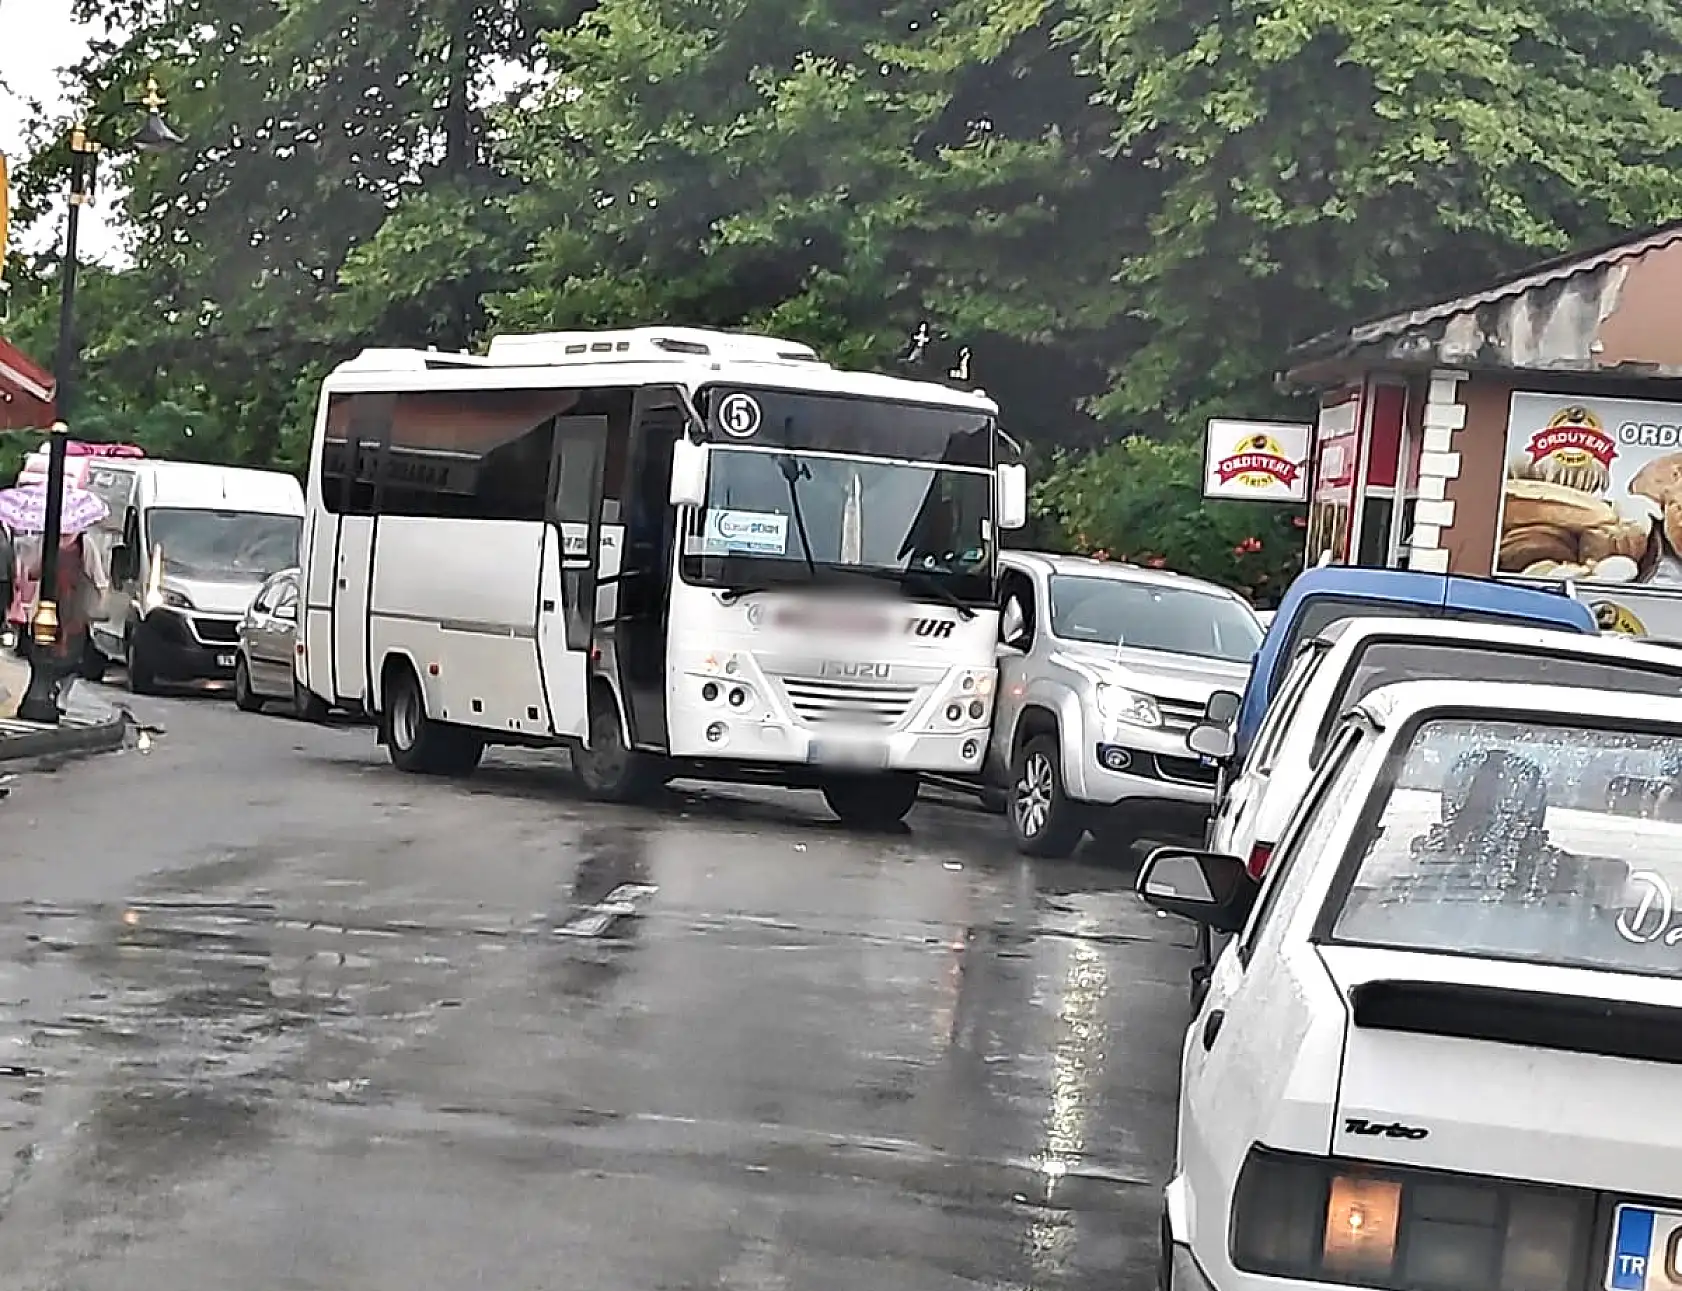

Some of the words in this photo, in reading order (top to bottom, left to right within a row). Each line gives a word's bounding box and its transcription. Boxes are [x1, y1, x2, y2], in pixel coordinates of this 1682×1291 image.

[731, 400, 750, 430] 5
[1618, 420, 1682, 446] ORD
[819, 659, 891, 678] ISUZU
[1345, 1119, 1429, 1139] Turbo
[1618, 1255, 1645, 1275] TR
